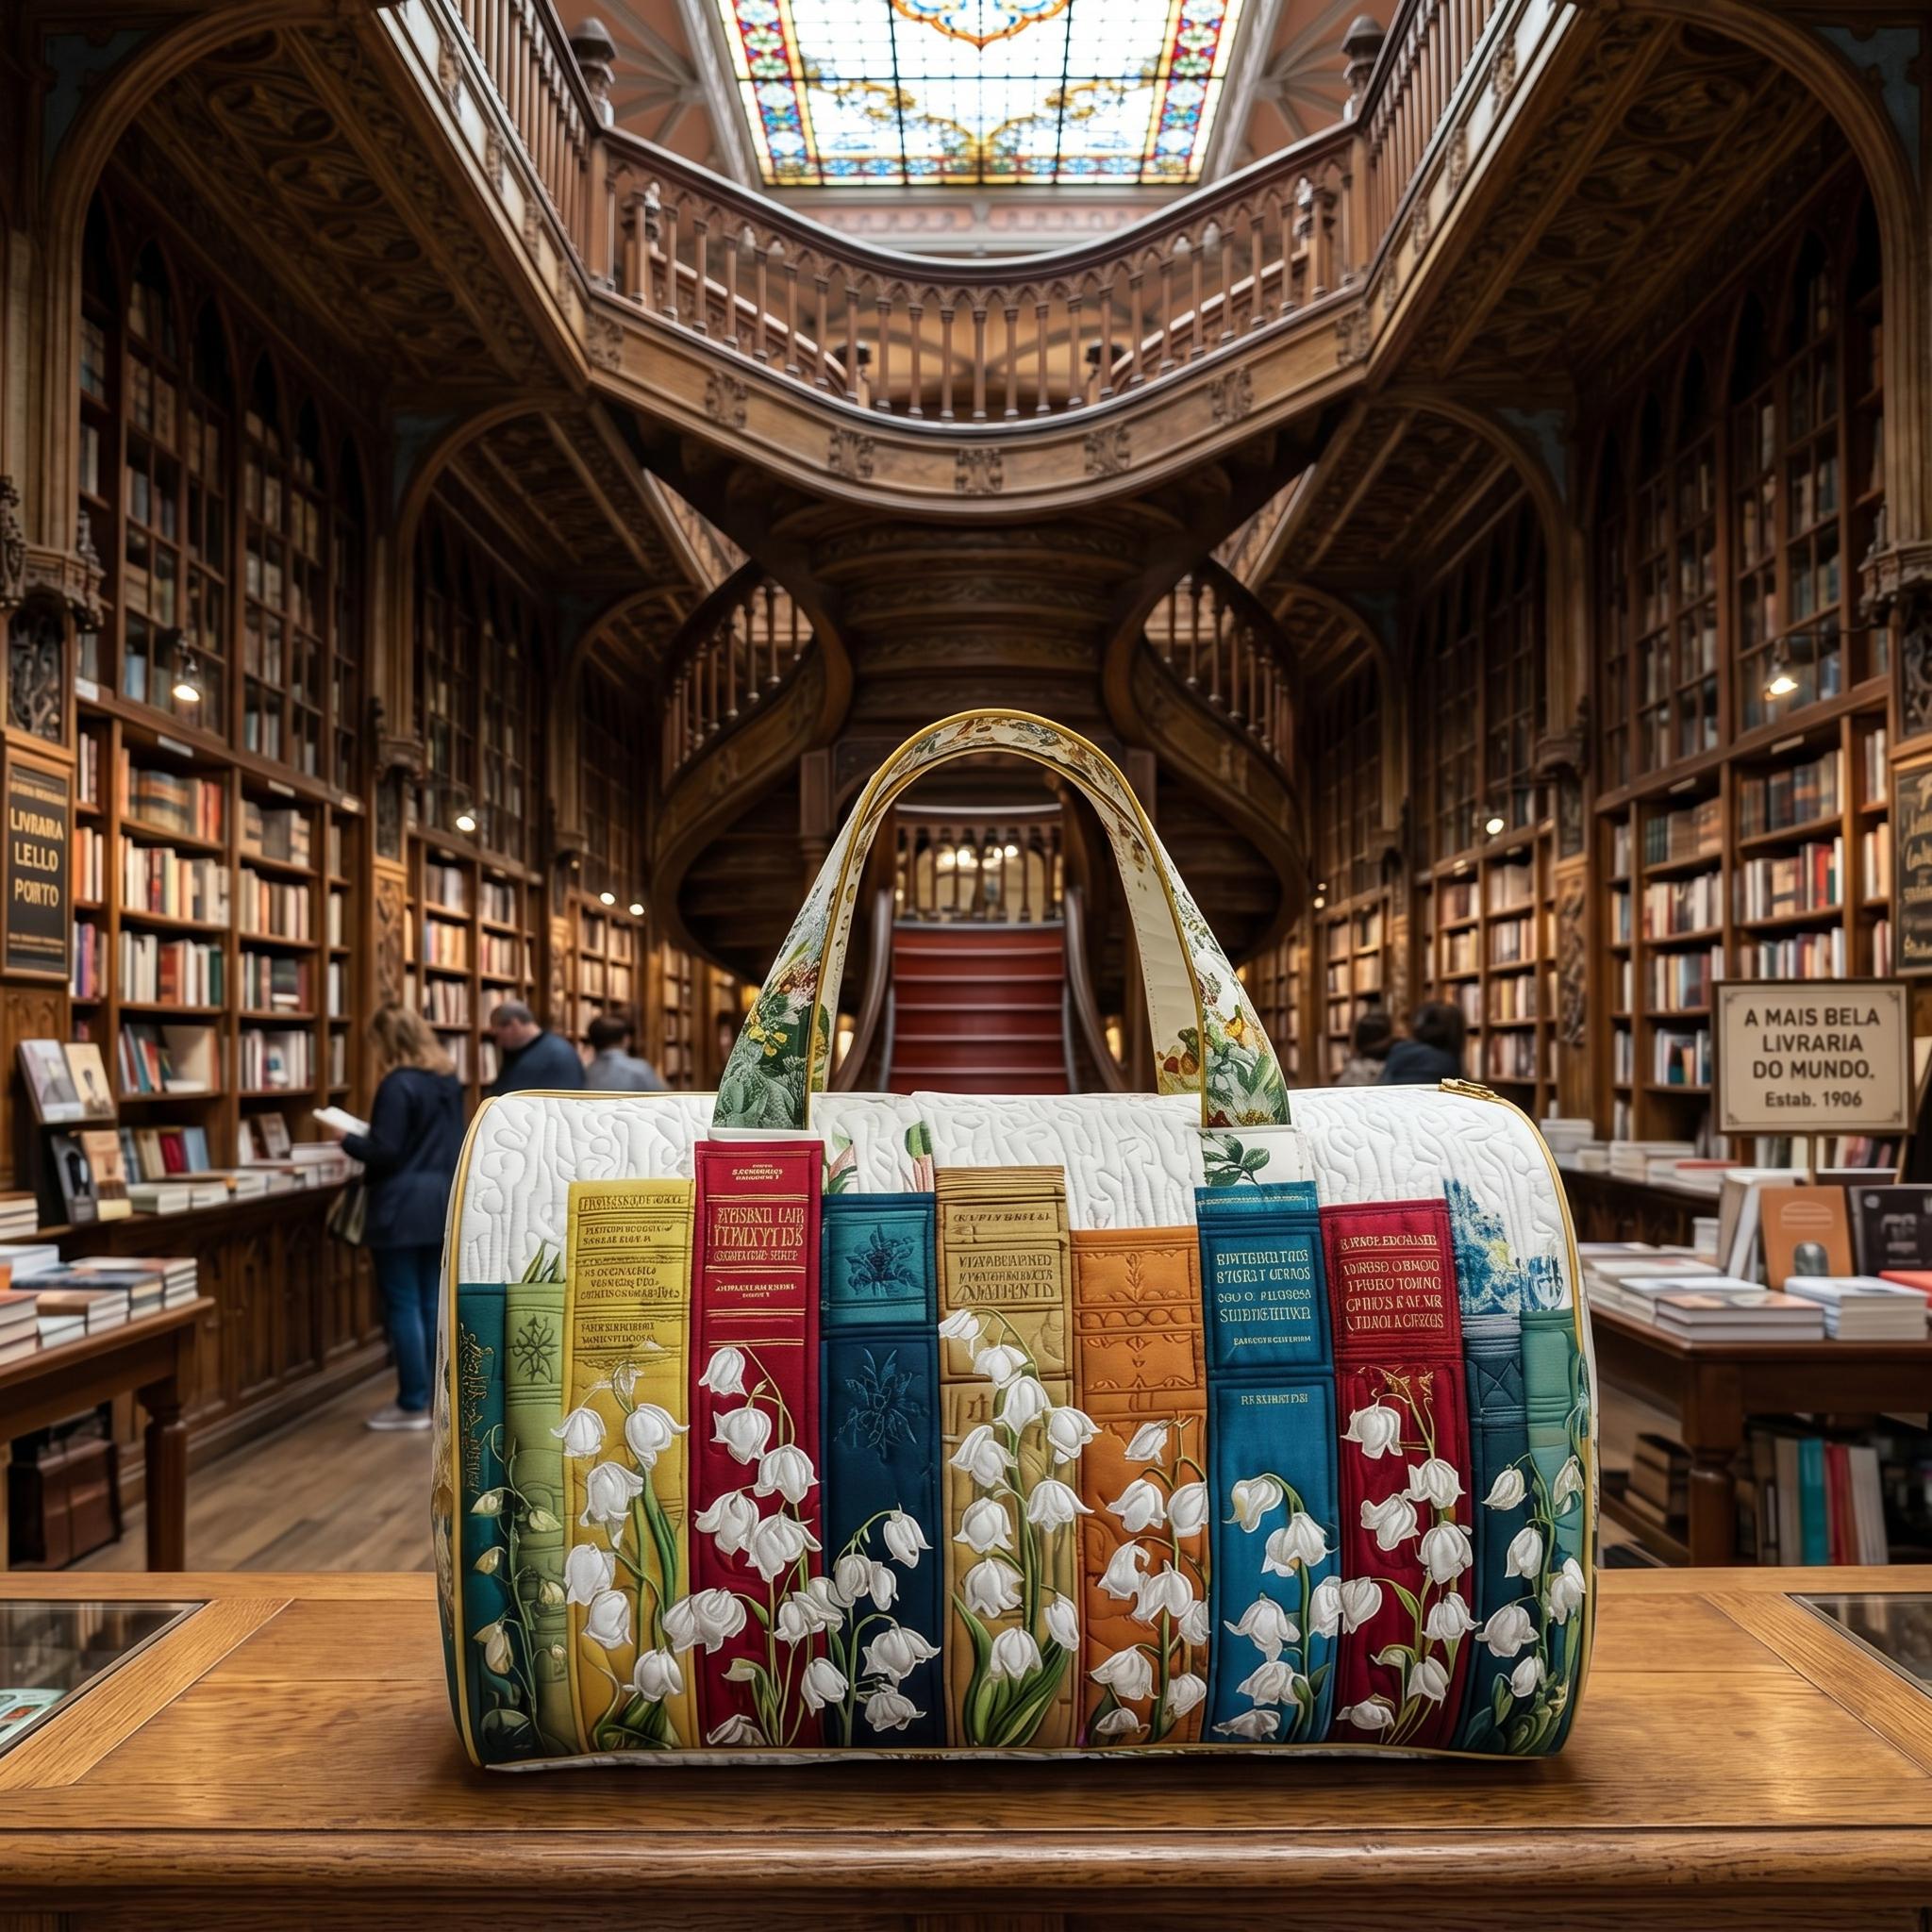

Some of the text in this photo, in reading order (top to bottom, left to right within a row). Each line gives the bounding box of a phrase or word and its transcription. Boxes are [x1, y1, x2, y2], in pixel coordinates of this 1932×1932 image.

[14, 841, 58, 873] LELLO
[1744, 1008, 1880, 1027] A MAIS BELA
[1762, 1034, 1863, 1052] LIVRARIA
[1753, 1059, 1875, 1079] DO MUNDO.
[1765, 1091, 1862, 1108] Estab. 1906
